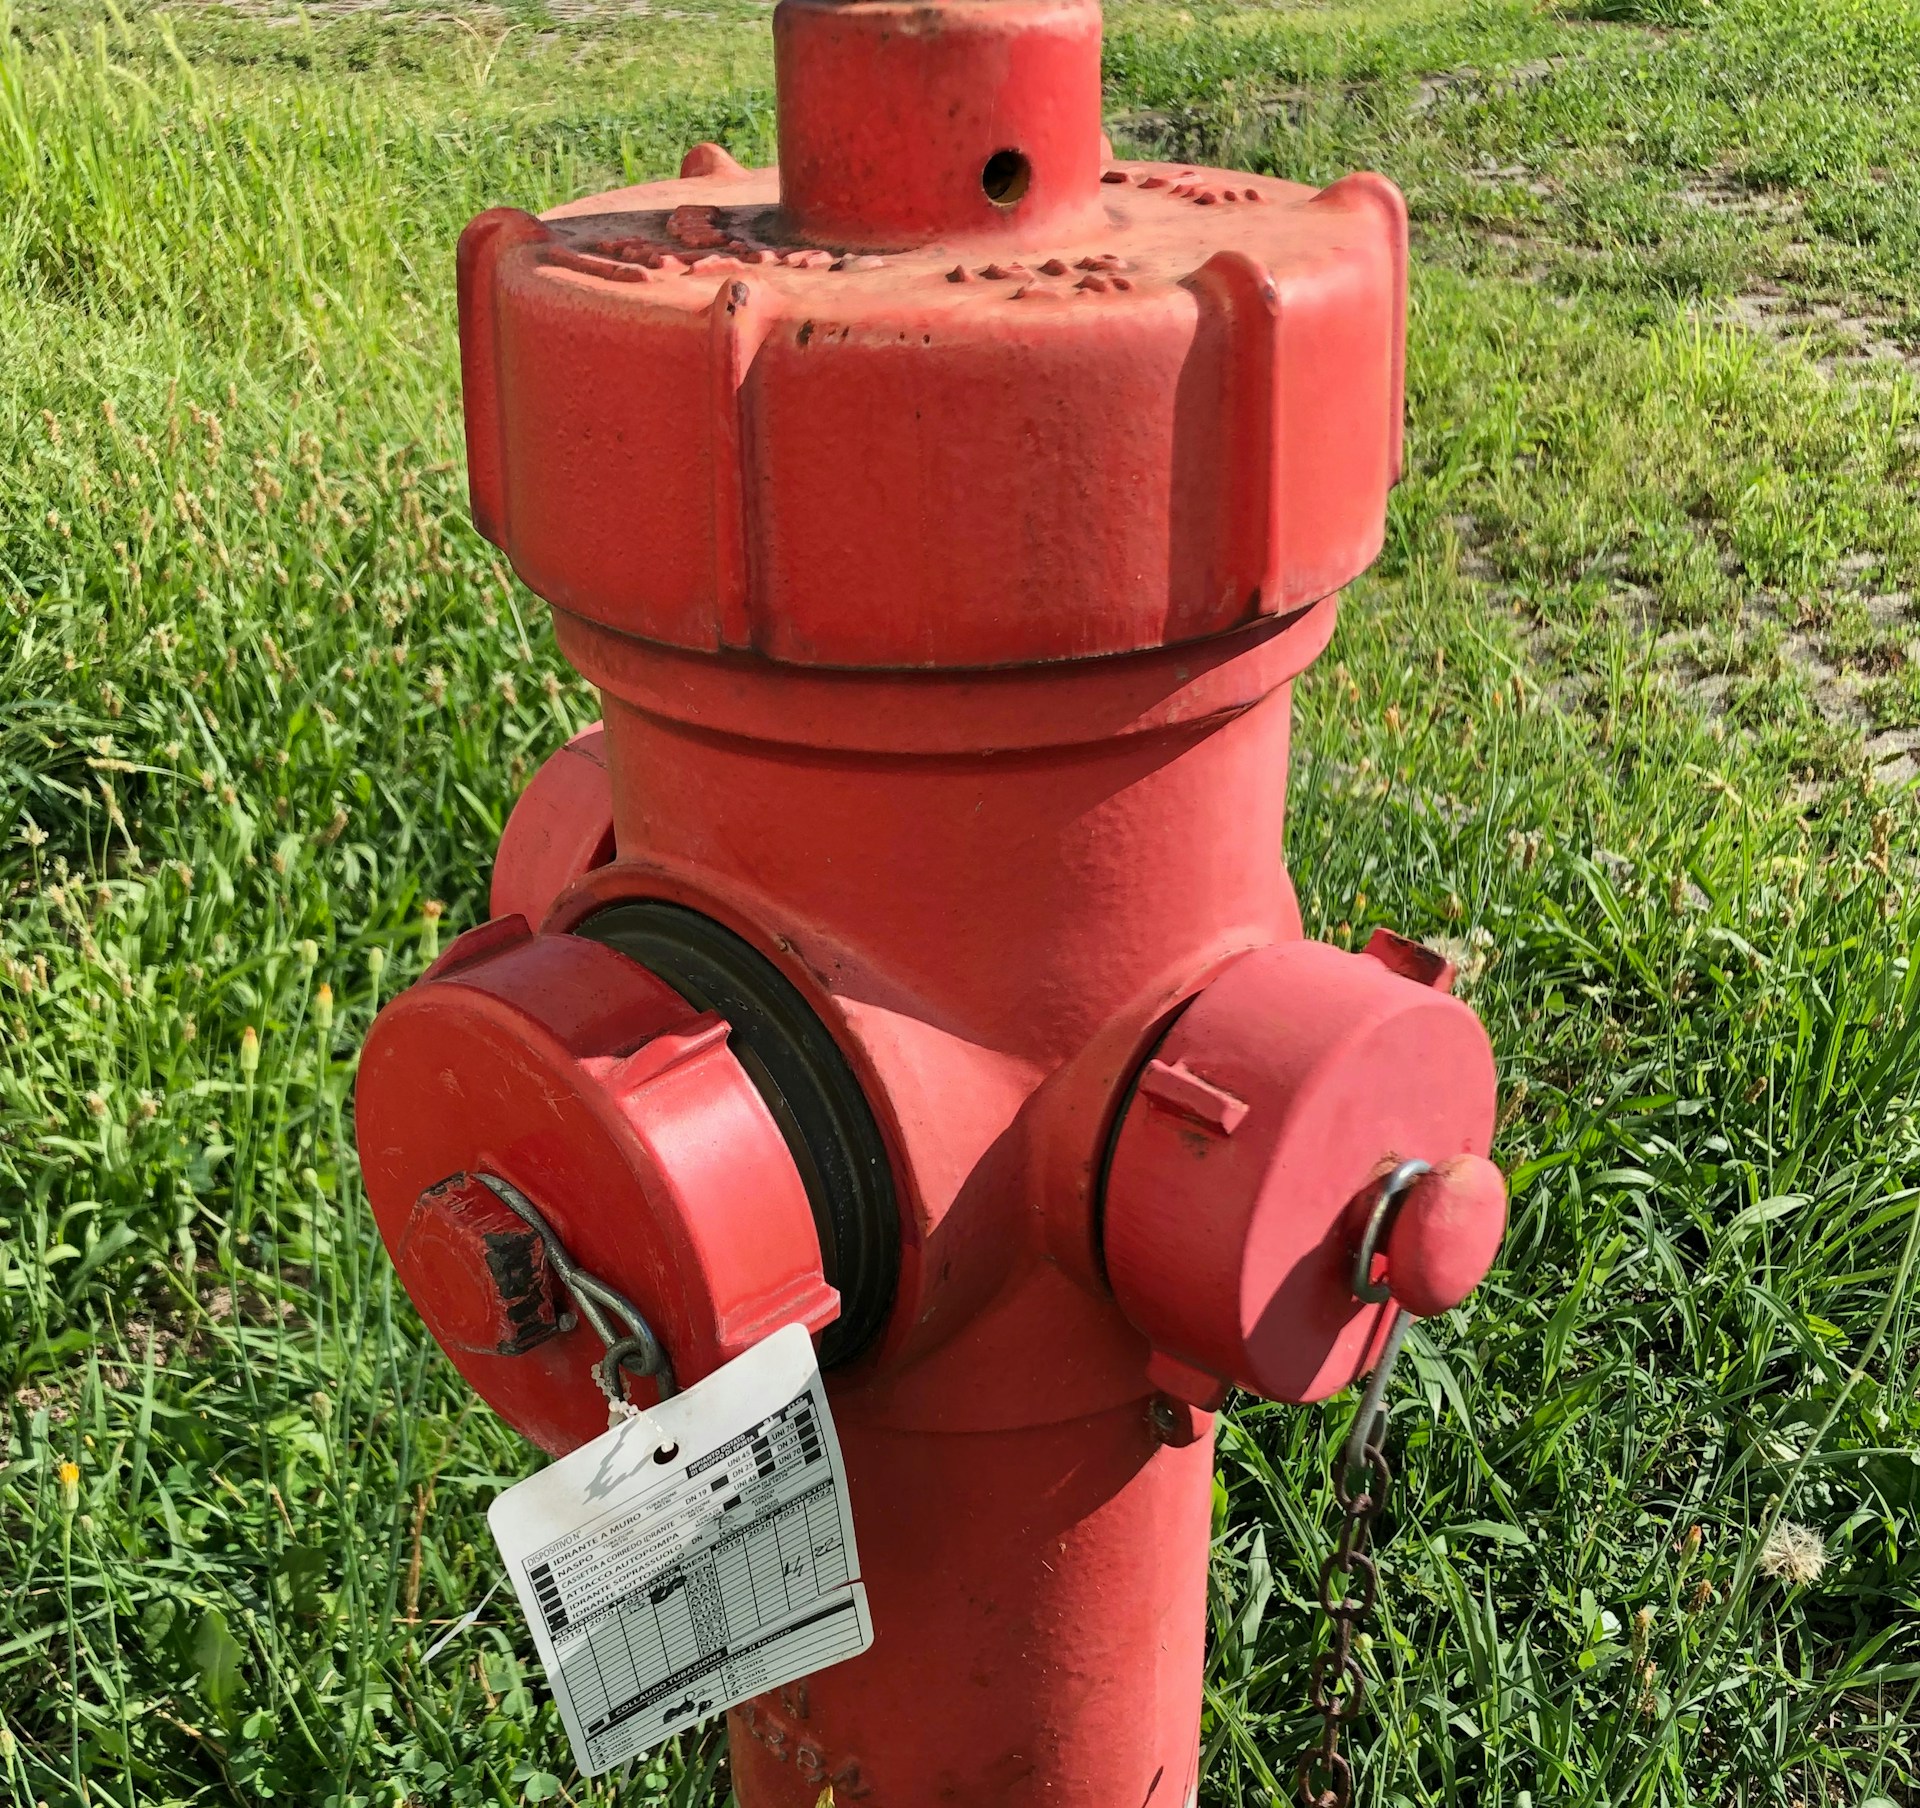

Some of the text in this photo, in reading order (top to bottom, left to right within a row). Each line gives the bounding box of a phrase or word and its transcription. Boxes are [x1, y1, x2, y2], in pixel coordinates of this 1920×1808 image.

[771, 1422, 795, 1441] UNI 70
[776, 1434, 798, 1451] DN 33
[688, 1433, 746, 1471] IMPIANTO DOTATO
[689, 1434, 755, 1476] DI GRUPPO DI SPINTA
[726, 1449, 750, 1468] UNI 45
[778, 1446, 802, 1465] UNI 70
[732, 1461, 753, 1478] DN 25
[733, 1473, 757, 1491] UNI 45
[684, 1488, 707, 1505] DN 19
[807, 1486, 831, 1504] 2022
[714, 1517, 766, 1549] REVISIONE
[780, 1481, 829, 1511] SEMESTRE
[776, 1504, 801, 1521] 2021
[746, 1520, 771, 1538] 2020
[552, 1511, 641, 1566] IDRANTE A MURO
[690, 1534, 703, 1545] DN
[716, 1537, 741, 1555] 2019
[526, 1529, 582, 1567] DISPOSITIVO N°
[560, 1519, 676, 1589] CASSETTA A CORREDO IDRANTE
[557, 1553, 594, 1577] NASPO
[565, 1531, 679, 1600] ATTACCO AUTOPOMPA
[680, 1551, 710, 1571] MESE
[569, 1542, 682, 1610] IDRANTE SOPRASSUOLO
[572, 1551, 685, 1619] IDRANTE SOTTOSUOLO
[687, 1577, 715, 1595] MAR
[689, 1584, 717, 1602] APR
[554, 1604, 610, 1639] REVISIONE
[624, 1567, 676, 1600] SEMESTRE
[619, 1591, 645, 1609] 2021
[690, 1591, 718, 1609] MAG
[692, 1597, 720, 1615] GIU
[588, 1609, 614, 1627] 2020
[694, 1604, 722, 1622] LUG
[695, 1611, 723, 1629] AGO
[555, 1627, 582, 1646] 2019
[697, 1625, 723, 1642] OTT
[699, 1630, 727, 1648] NOV
[701, 1637, 728, 1654] DIC
[739, 1648, 761, 1662] visita
[741, 1657, 763, 1671] visita
[646, 1685, 677, 1705] Firma
[690, 1668, 707, 1681] chi
[708, 1649, 747, 1672] esegue
[757, 1627, 791, 1647] lavoro
[743, 1666, 766, 1680] visita
[614, 1681, 667, 1716] COLLAUDO
[667, 1651, 722, 1685] TUBAZIONE
[745, 1675, 768, 1688] visita
[605, 1720, 628, 1735] visita
[607, 1728, 630, 1743] visita
[610, 1736, 632, 1750] visita
[611, 1742, 634, 1757] visita
